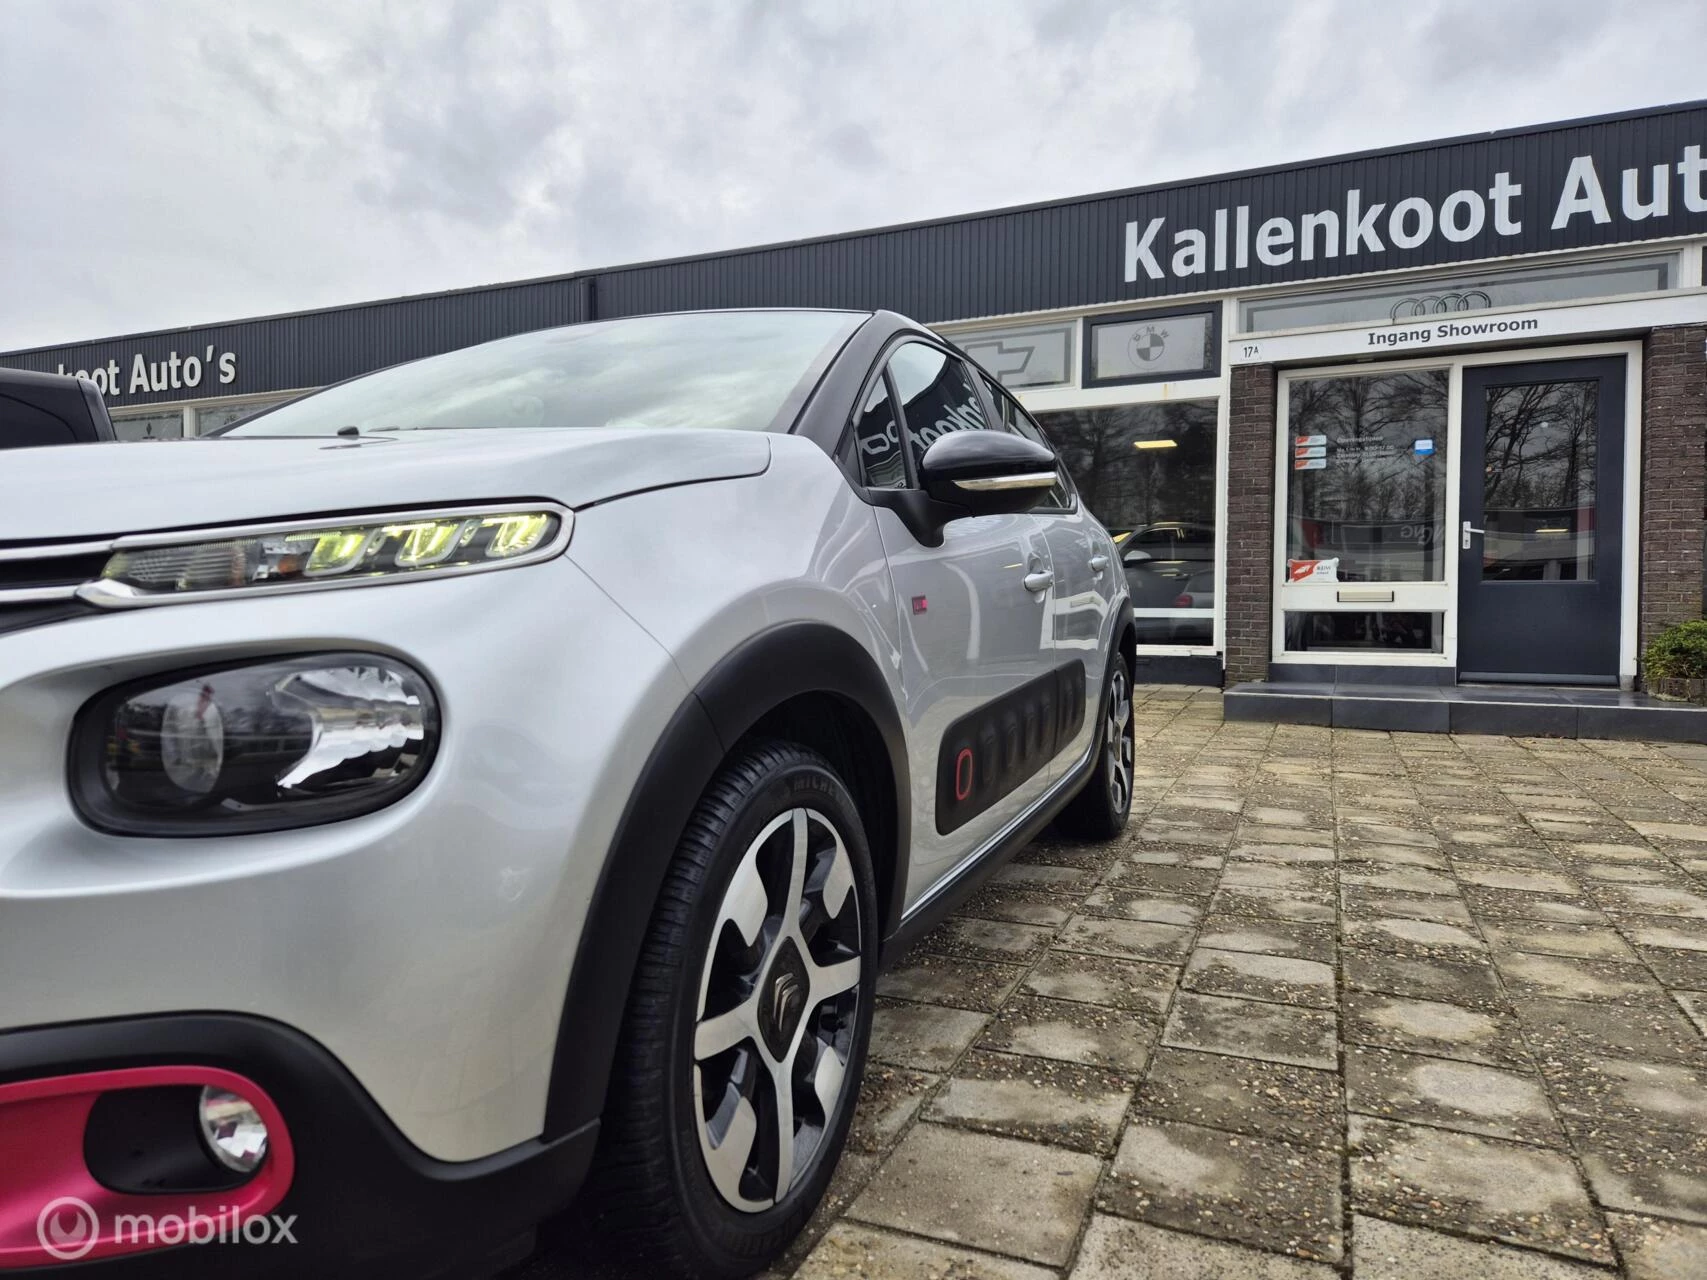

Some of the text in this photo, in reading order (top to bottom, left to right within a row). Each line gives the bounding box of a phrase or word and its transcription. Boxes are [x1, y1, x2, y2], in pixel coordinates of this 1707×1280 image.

[1124, 171, 1522, 283] Kallenkoot
[1367, 318, 1538, 346] Ingang Showroom
[129, 345, 236, 393] Auto's
